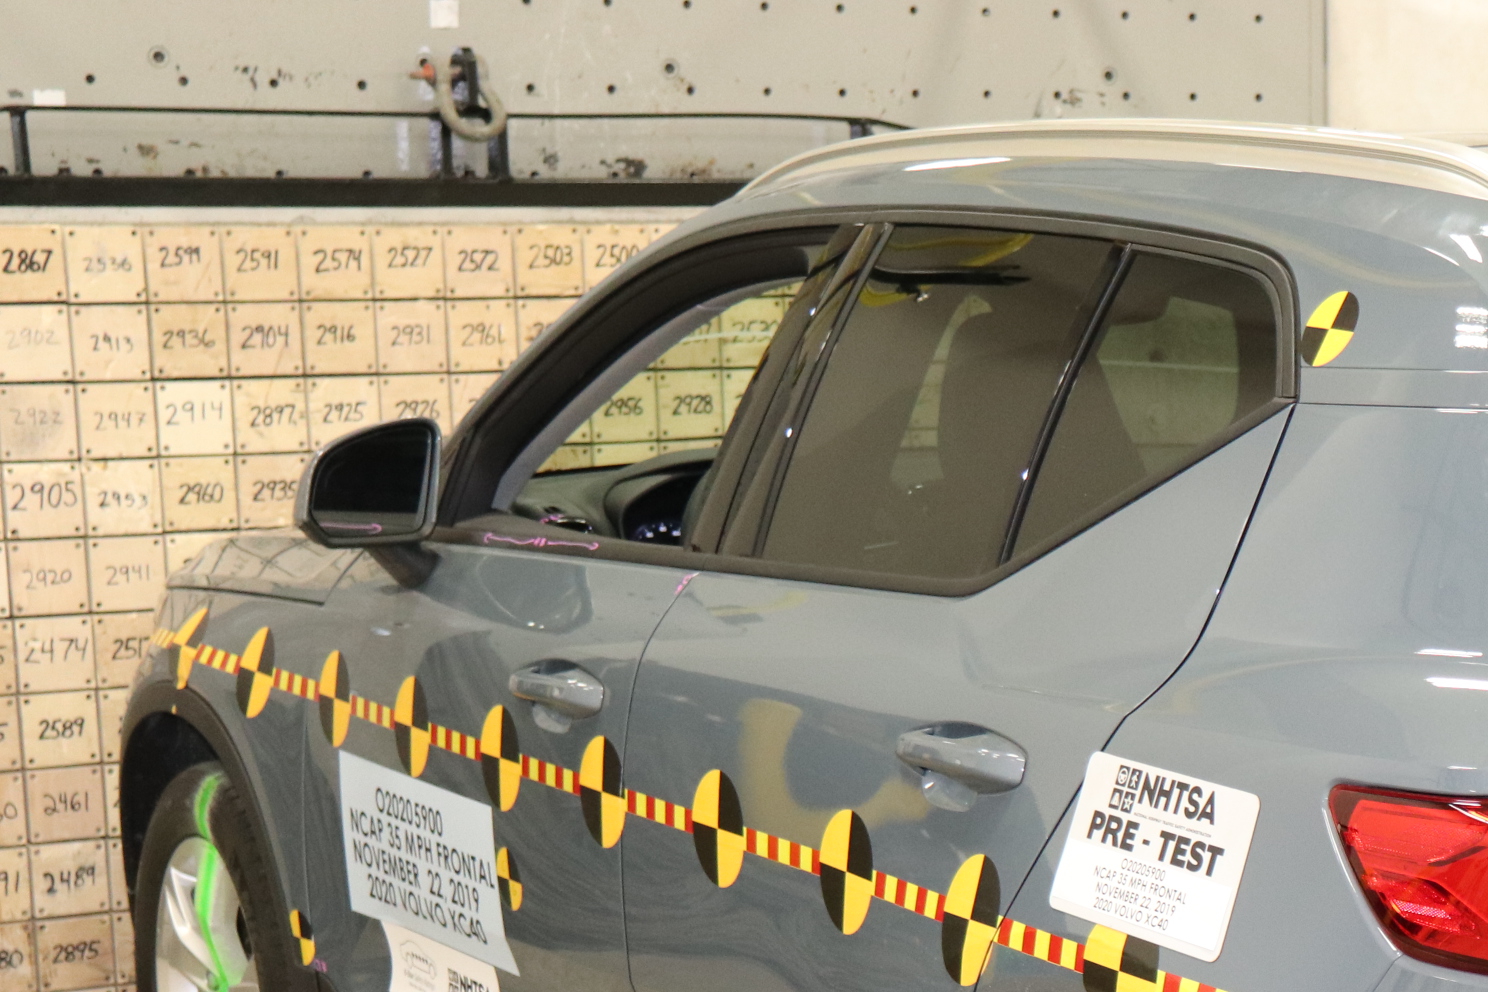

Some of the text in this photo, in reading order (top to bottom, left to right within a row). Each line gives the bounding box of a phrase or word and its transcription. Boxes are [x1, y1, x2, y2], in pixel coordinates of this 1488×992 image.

[1, 247, 53, 274] 2867
[157, 244, 200, 269] 2599
[235, 247, 279, 273] 2591
[312, 247, 362, 274] 2574
[387, 245, 433, 269] 2527
[457, 249, 499, 273] 2572
[528, 244, 573, 270] 2503
[90, 333, 134, 353] 2913
[161, 328, 216, 350] 2936
[240, 323, 289, 350] 2904
[315, 323, 357, 346] 2916
[390, 323, 431, 347] 2931
[165, 400, 223, 426] 2914
[322, 401, 367, 423] 2925
[672, 394, 714, 416] 2928
[93, 410, 146, 431] 2947
[10, 480, 77, 511] 2905
[178, 482, 224, 505] 2960
[252, 480, 298, 502] 2935
[22, 567, 72, 590] 2920
[104, 564, 150, 586] 2941
[25, 637, 88, 663] 2474
[38, 717, 85, 740] 2589
[42, 791, 89, 816] 2461
[1138, 772, 1215, 825] NHTSA
[350, 807, 496, 890] NCAP 35 MPH FRONTAL
[1086, 809, 1140, 852] PRE
[1157, 830, 1225, 877] TEST
[42, 864, 96, 896] 2489
[353, 838, 480, 914] NOVEMBER 22, 2019
[1093, 866, 1187, 905] NCAP 35 MPH FRONTAL
[367, 874, 488, 945] 2020 VOLVO XC40
[1095, 881, 1139, 905] NOVEMBER
[1154, 899, 1176, 917] 2019
[1093, 897, 1169, 931] 2020 VOLVO XC40
[52, 941, 101, 965] 2895
